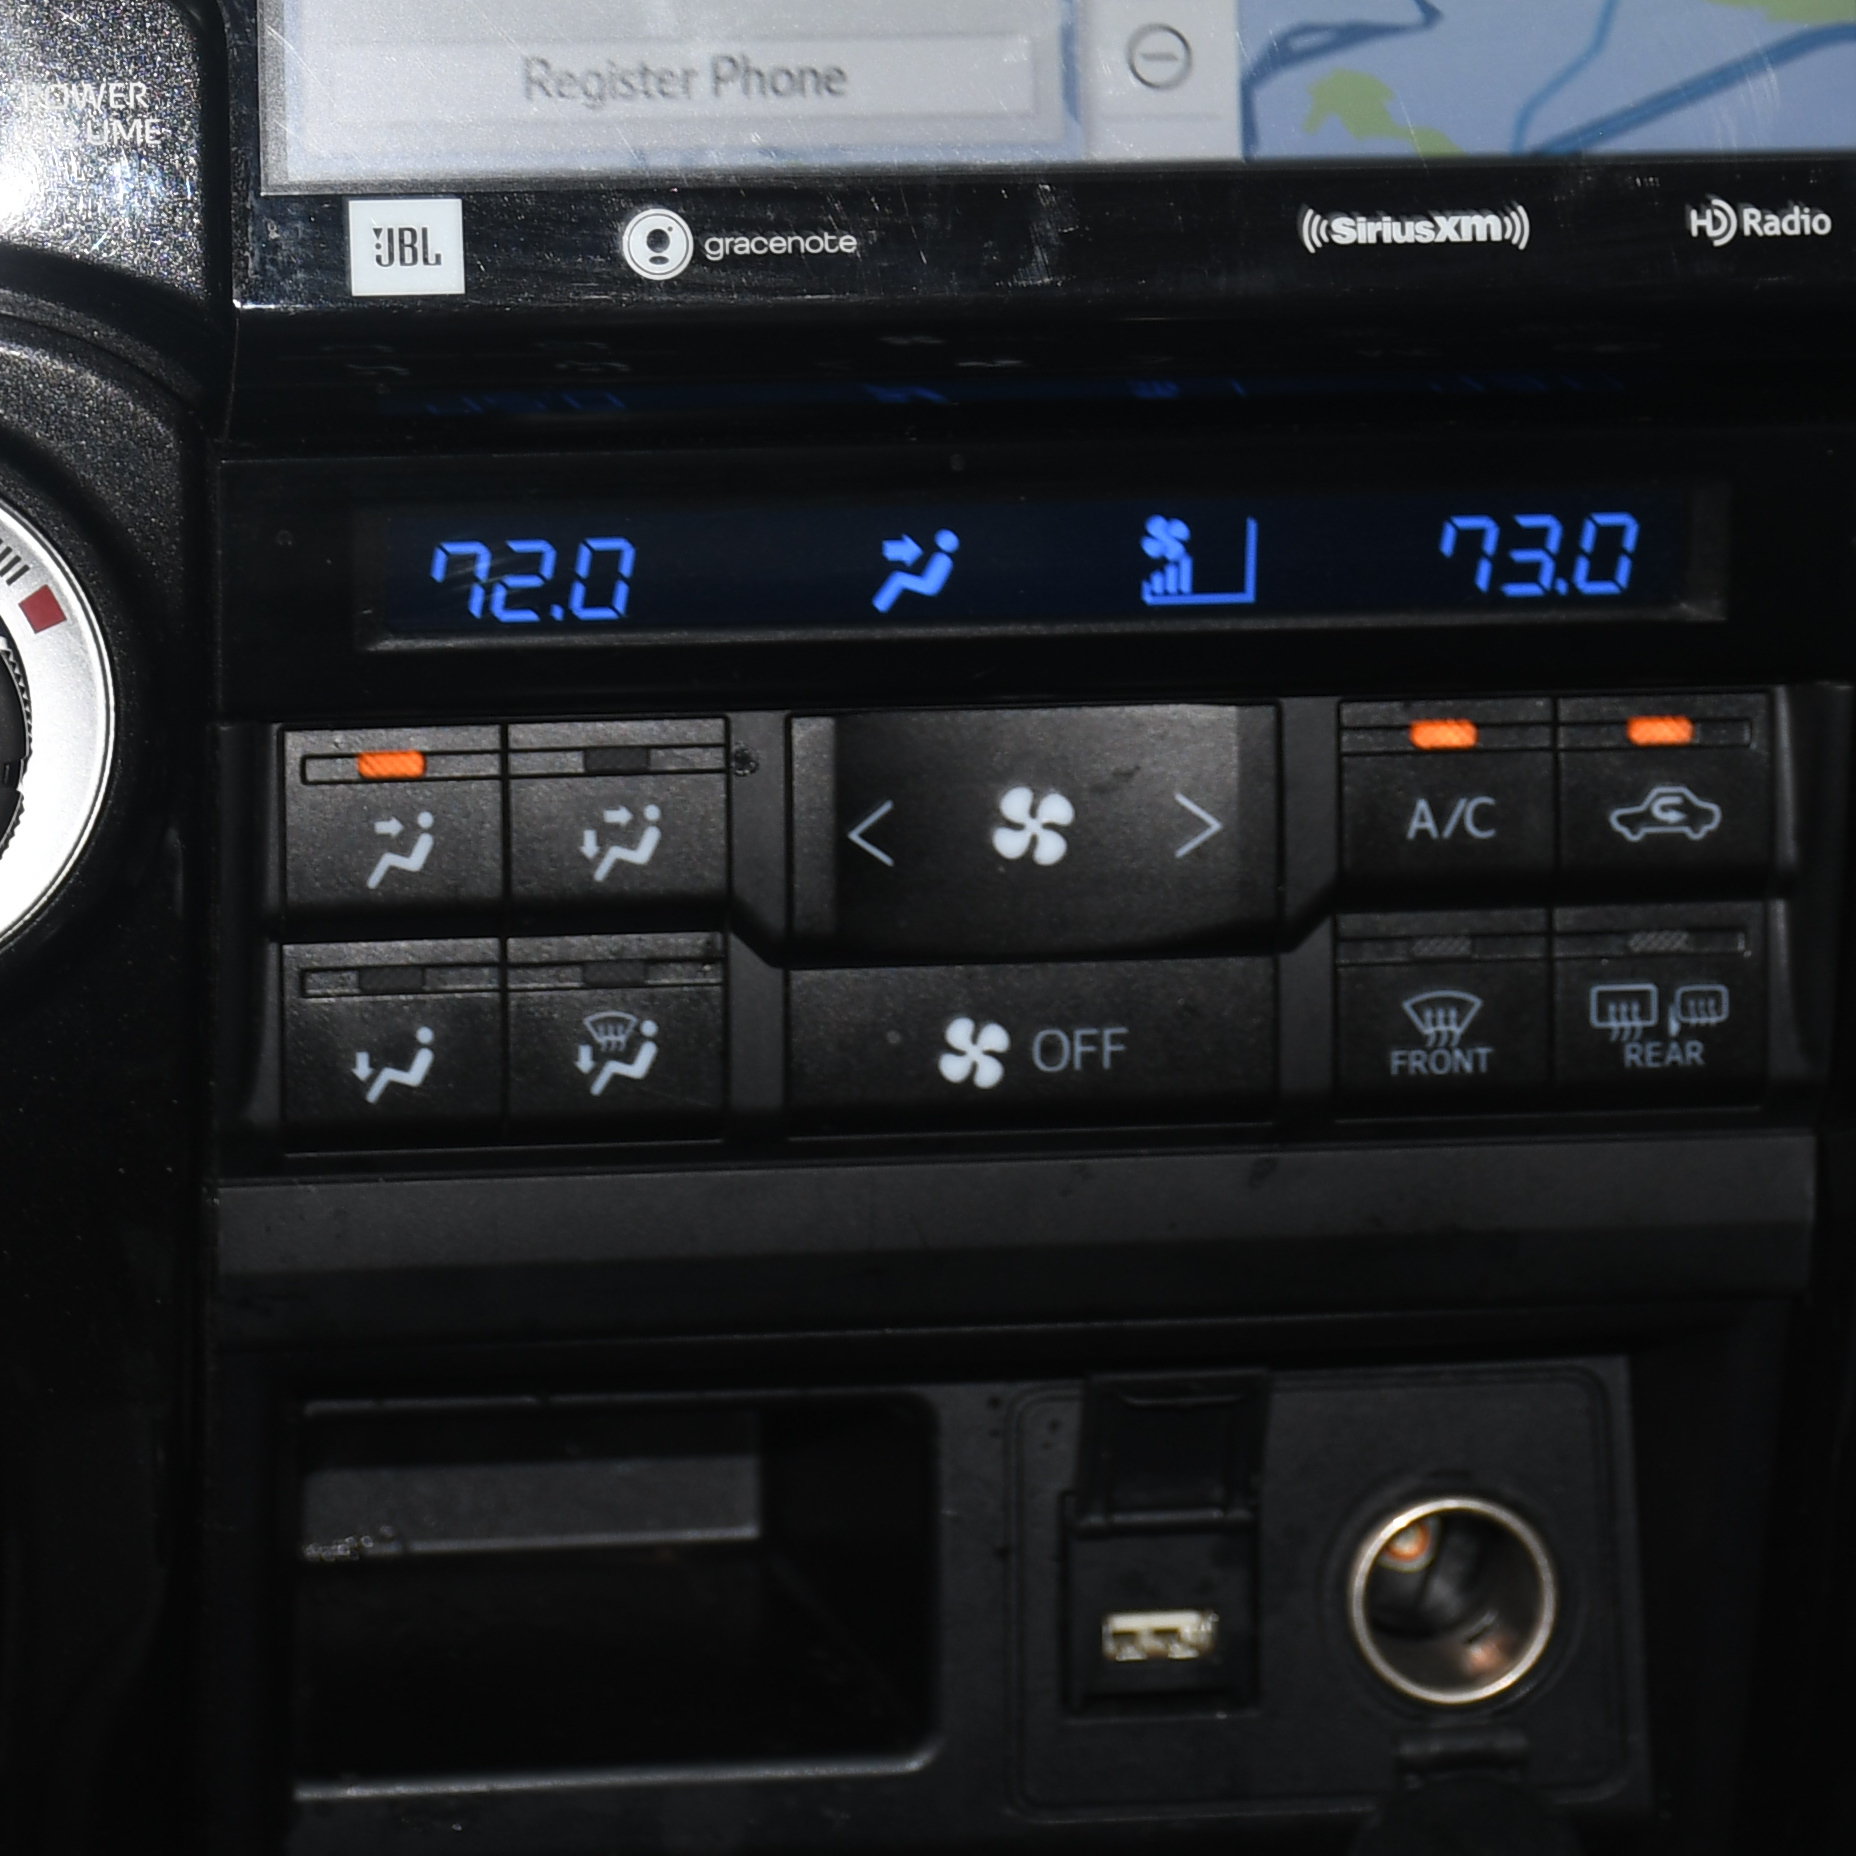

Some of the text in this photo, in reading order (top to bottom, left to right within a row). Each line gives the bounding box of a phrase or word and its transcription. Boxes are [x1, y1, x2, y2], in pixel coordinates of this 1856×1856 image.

[522, 53, 848, 110] Register Phone
[1743, 205, 1832, 237] Radio
[372, 226, 442, 267] JBL
[704, 231, 858, 261] gracenote
[1440, 511, 1640, 596] 73.0
[430, 537, 637, 622] 72.0
[1407, 797, 1497, 840] A/C
[1031, 1027, 1128, 1073] OFF
[1390, 1048, 1493, 1075] FRONT
[1624, 1041, 1704, 1068] REAR
